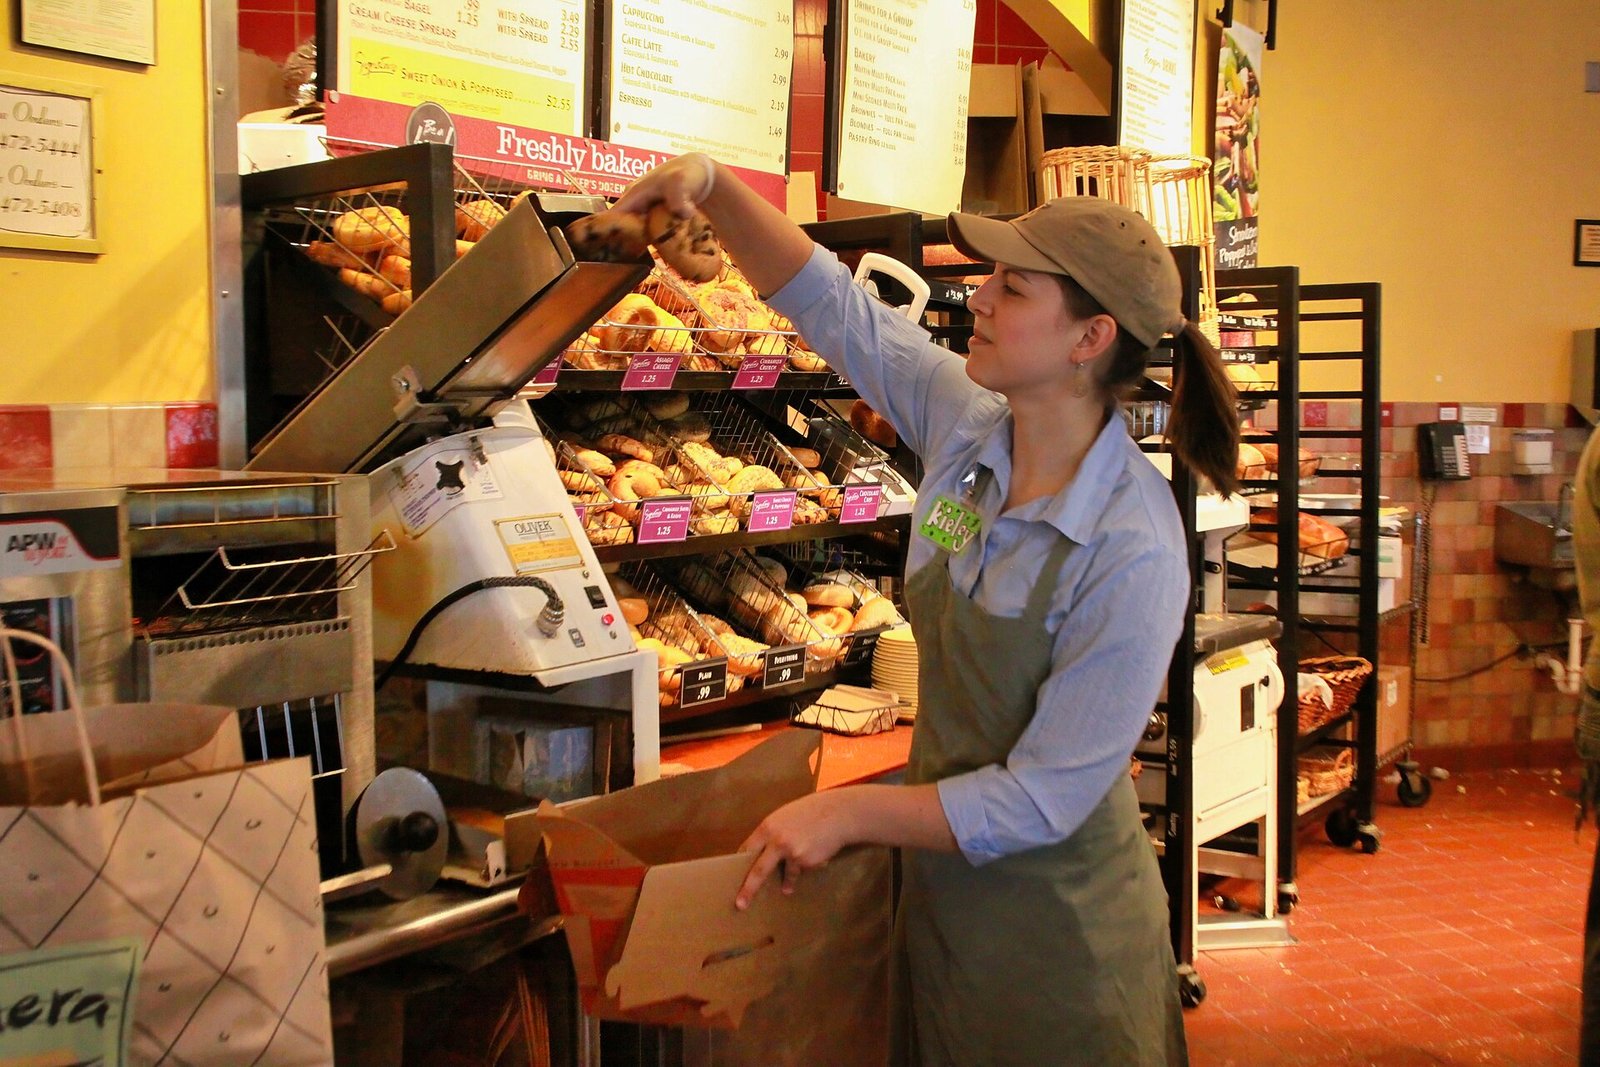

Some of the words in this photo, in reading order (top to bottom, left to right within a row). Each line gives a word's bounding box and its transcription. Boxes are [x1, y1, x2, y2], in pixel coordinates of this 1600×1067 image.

[349, 2, 380, 20] CREAM
[384, 11, 417, 30] CHEESE
[420, 20, 457, 39] SPREADS
[520, 12, 550, 30] SPREAD
[622, 4, 664, 24] CAPPUCCINO
[854, 0, 876, 15] DRINKS
[893, 12, 914, 27] GROUP
[457, 10, 479, 27] 1.25
[519, 26, 549, 44] SPREAD
[621, 33, 642, 47] CAFFE
[643, 38, 663, 53] LATTE
[774, 47, 789, 60] 2.99
[854, 47, 876, 64] BAKERY
[621, 62, 635, 75] HOT
[636, 66, 673, 84] CHOCOLATE
[772, 73, 787, 86] 2.99
[401, 67, 428, 83] SWEET
[431, 73, 458, 89] ONION
[470, 81, 513, 100] POPPYSEED
[619, 91, 652, 108] ESPRESSO
[770, 99, 785, 112] 2.19
[850, 104, 876, 119] BROWNIES
[768, 125, 783, 137] 1.49
[849, 118, 874, 132] BLONDIES
[848, 132, 868, 144] PASTRY
[496, 125, 587, 172] Freshly
[591, 143, 656, 178] baked
[556, 174, 562, 184] A
[641, 374, 657, 383] 1.25
[750, 375, 764, 383] 1.25
[854, 508, 866, 516] 1.25
[514, 520, 552, 534] OLIVER
[765, 516, 778, 525] 1.25
[656, 525, 671, 536] 1.25
[6, 532, 57, 553] APW
[698, 671, 712, 680] PLAIN
[779, 668, 791, 682] .99
[697, 685, 711, 700] .99
[0, 988, 109, 1034] era
